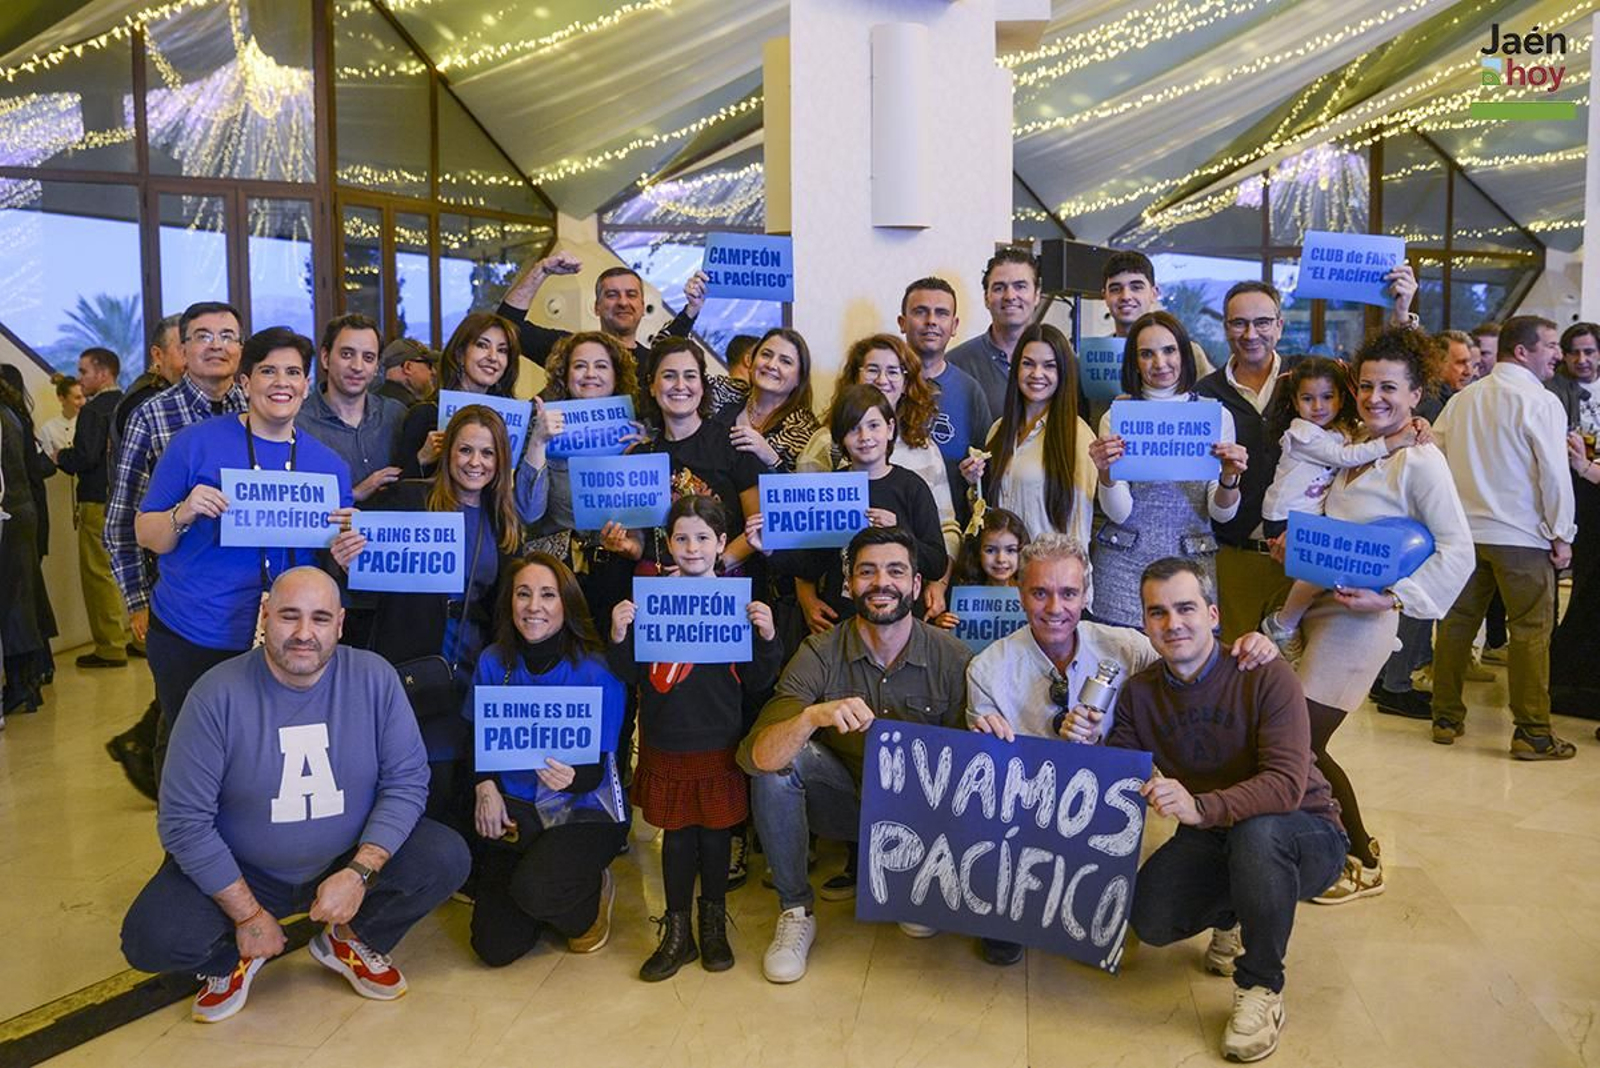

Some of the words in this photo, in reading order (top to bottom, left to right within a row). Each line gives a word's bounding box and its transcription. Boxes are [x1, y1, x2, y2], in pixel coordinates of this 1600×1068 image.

[709, 246, 781, 267] CAMPEÓN
[1311, 247, 1344, 262] CLUB
[1346, 250, 1364, 264] de
[1365, 251, 1397, 267] FANS
[1086, 350, 1114, 363] CLUB
[506, 412, 523, 428] DEL
[591, 408, 606, 422] ES
[607, 407, 629, 420] DEL
[1120, 420, 1154, 436] CLUB
[1157, 421, 1175, 436] de
[1177, 421, 1212, 437] FANS
[580, 471, 625, 488] TODOS
[628, 470, 660, 487] CON
[235, 482, 325, 503] CAMPEÓN
[766, 489, 782, 503] EL
[783, 488, 816, 503] RING
[818, 487, 834, 502] ES
[837, 487, 861, 502] DEL
[768, 507, 861, 532] PACÍFICO
[376, 527, 411, 543] RING
[414, 527, 431, 543] ES
[433, 527, 456, 543] DEL
[1295, 528, 1331, 548] CLUB
[1333, 536, 1353, 552] de
[1355, 540, 1391, 559] FANS
[357, 547, 456, 575] PACÍFICO
[646, 592, 736, 616] CAMPEÓN
[957, 599, 969, 612] EL
[972, 599, 1002, 613] RING
[1005, 600, 1020, 613] ES
[483, 703, 499, 718] EL
[502, 703, 540, 718] RING
[544, 703, 562, 718] ES
[565, 703, 592, 718] DEL
[484, 722, 592, 751] PACÍFICO
[271, 723, 345, 823] A
